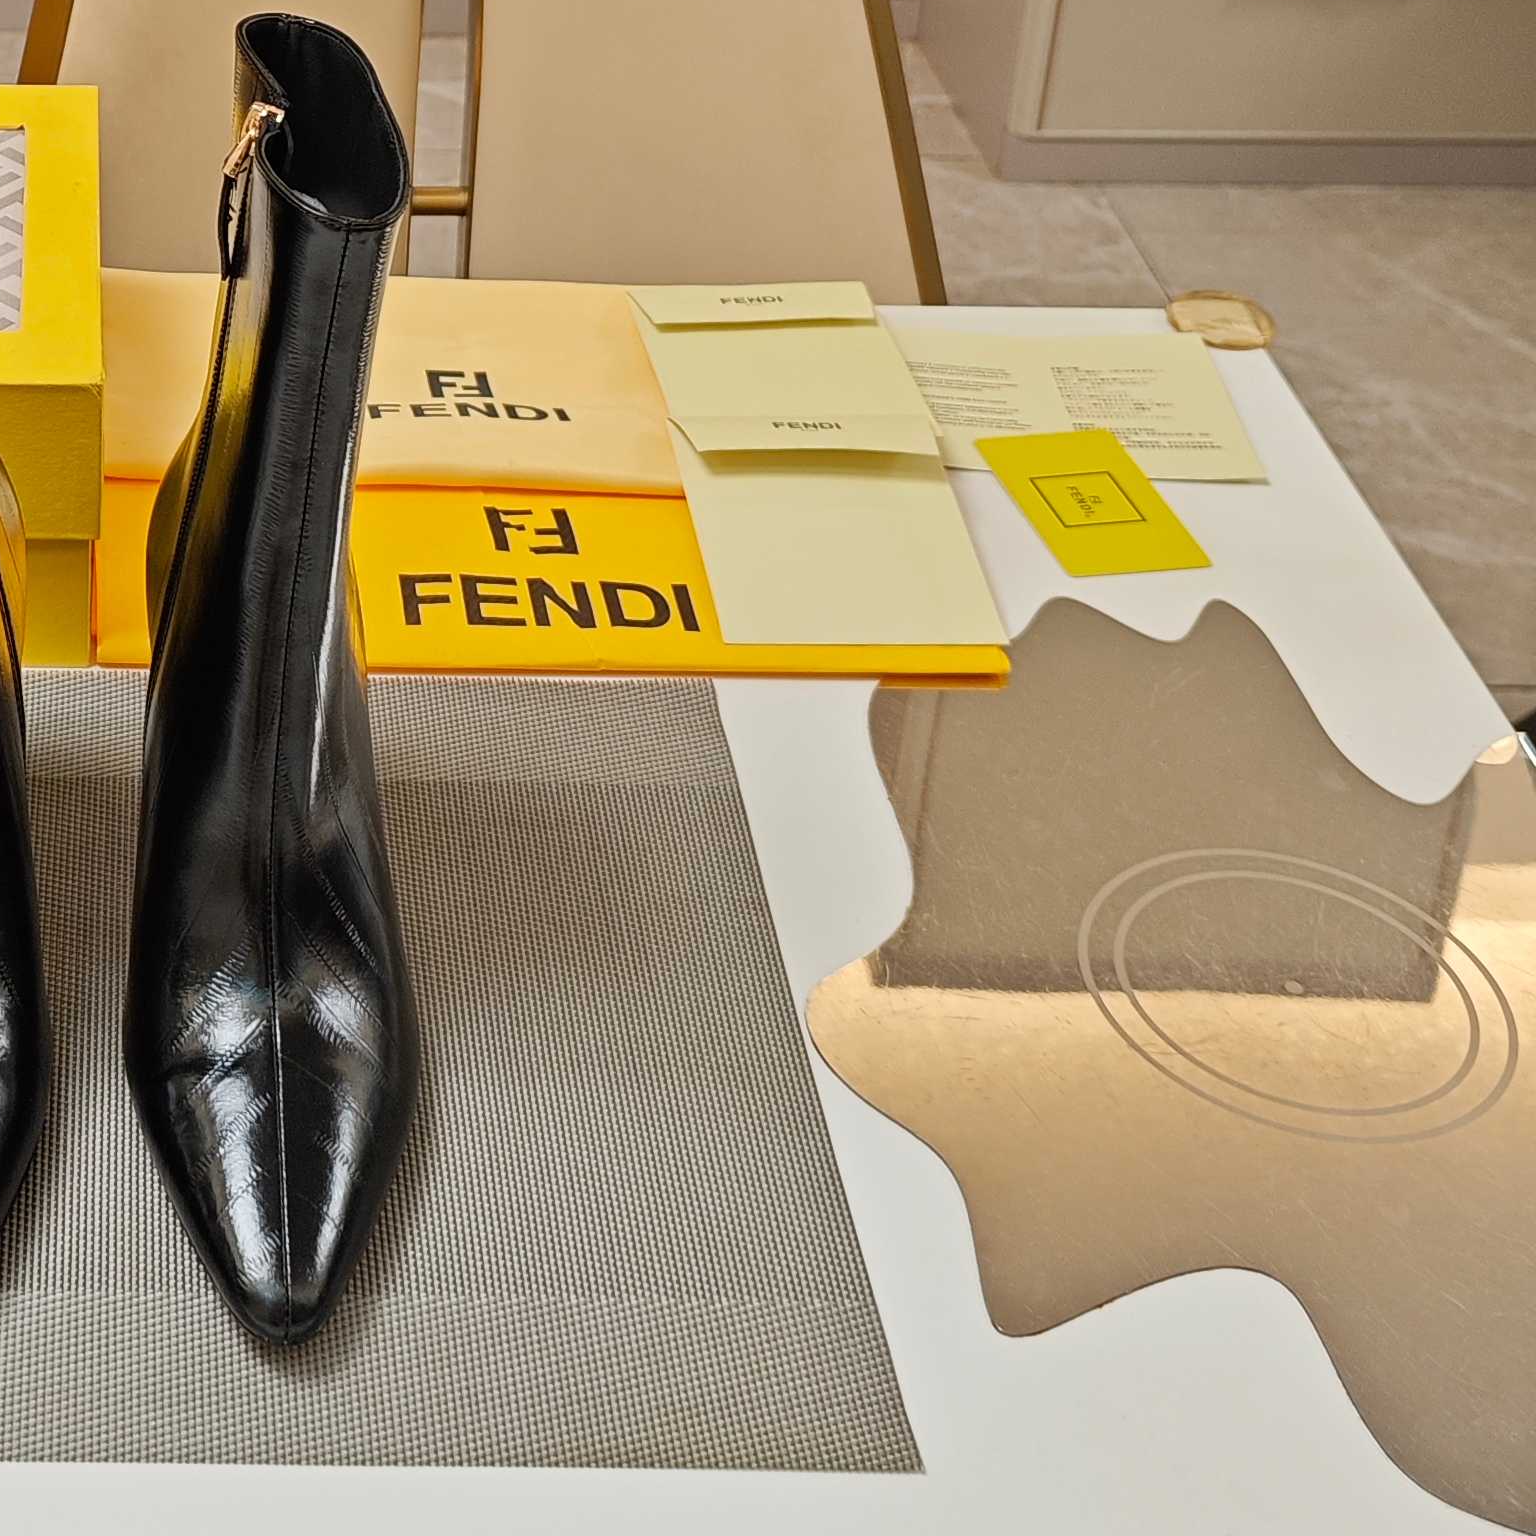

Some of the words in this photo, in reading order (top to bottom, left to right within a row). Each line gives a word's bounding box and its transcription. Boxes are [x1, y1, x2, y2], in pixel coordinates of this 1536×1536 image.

[719, 295, 784, 305] FENDI
[367, 403, 571, 422] FENDI
[771, 421, 843, 431] FENDI
[398, 573, 701, 632] FENDI
